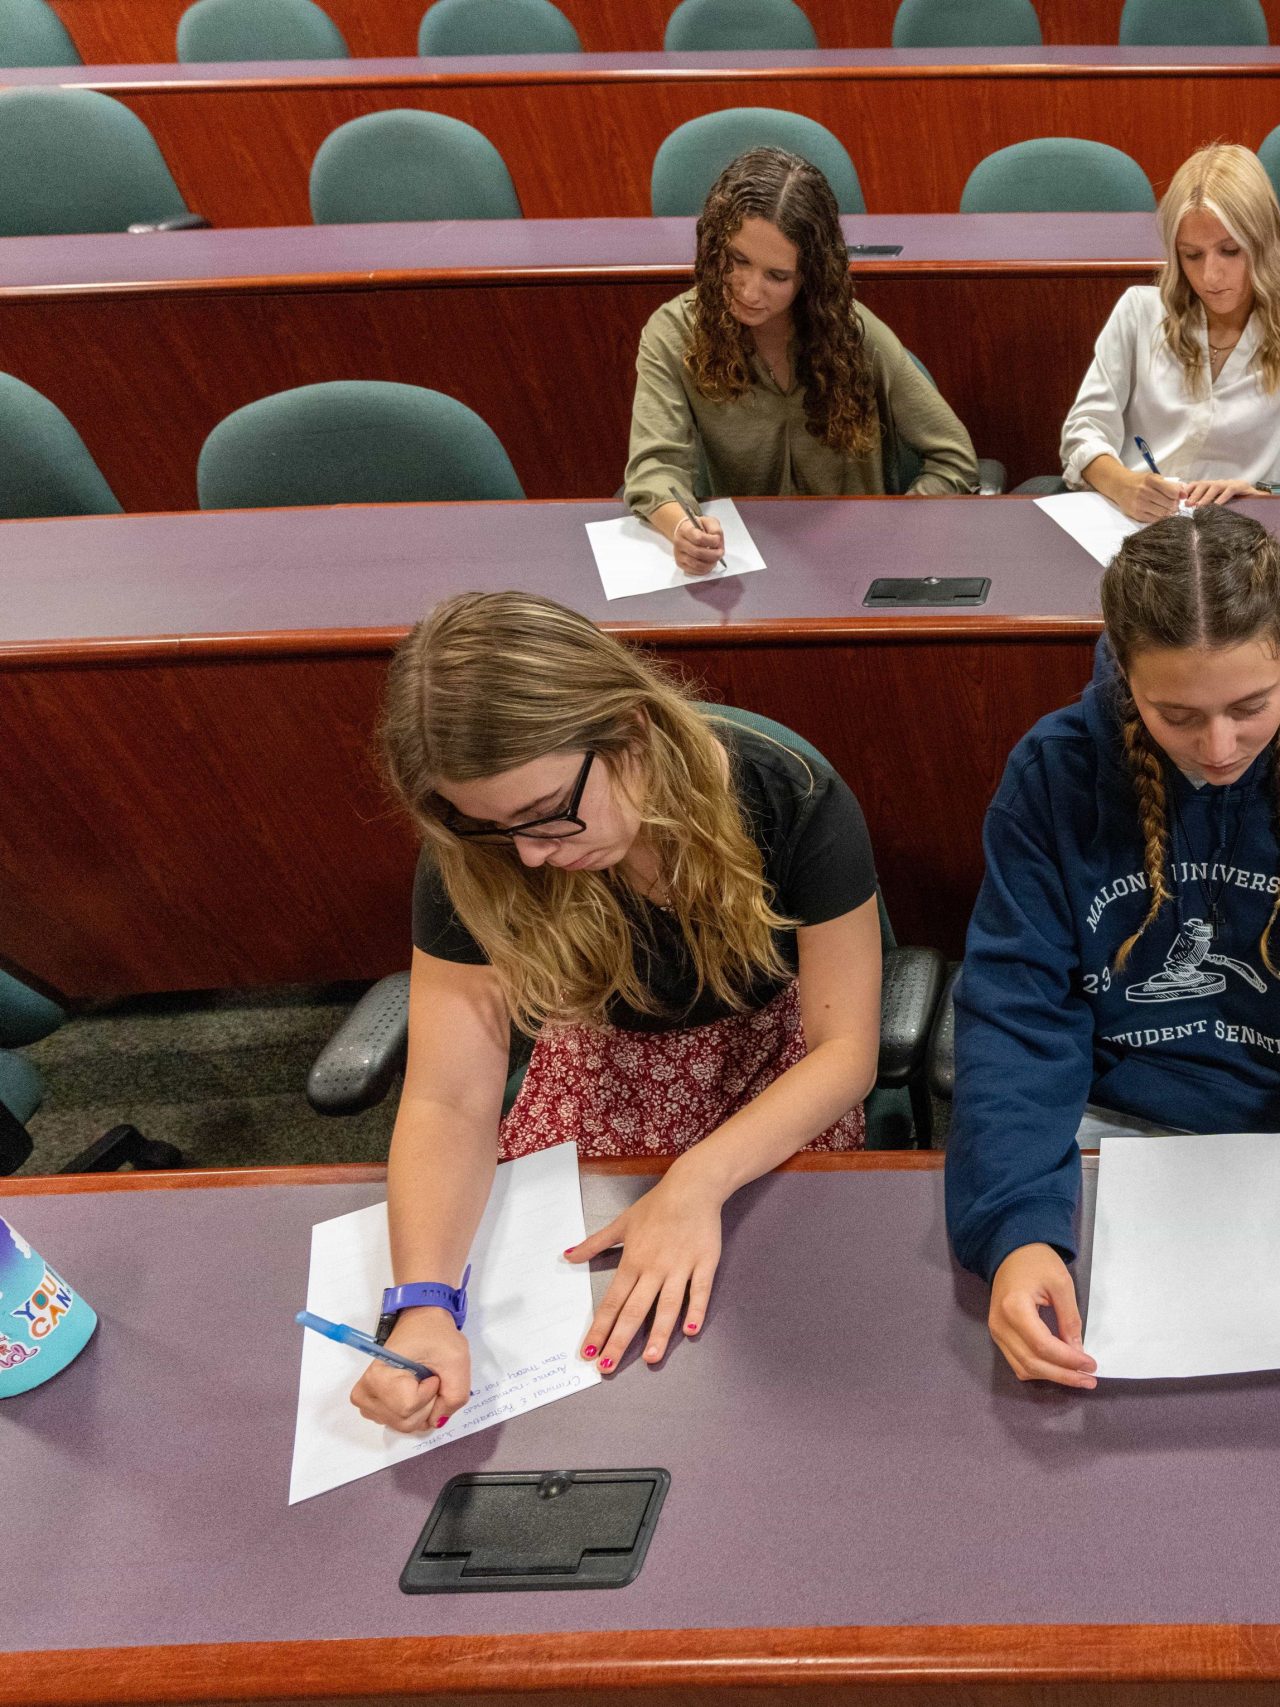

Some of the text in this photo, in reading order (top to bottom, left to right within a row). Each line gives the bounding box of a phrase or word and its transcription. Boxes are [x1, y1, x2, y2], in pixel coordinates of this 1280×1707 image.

[1086, 871, 1154, 933] MALON
[1083, 966, 1112, 994] 23
[13, 1274, 57, 1321] YOU
[31, 1287, 71, 1338] CAN
